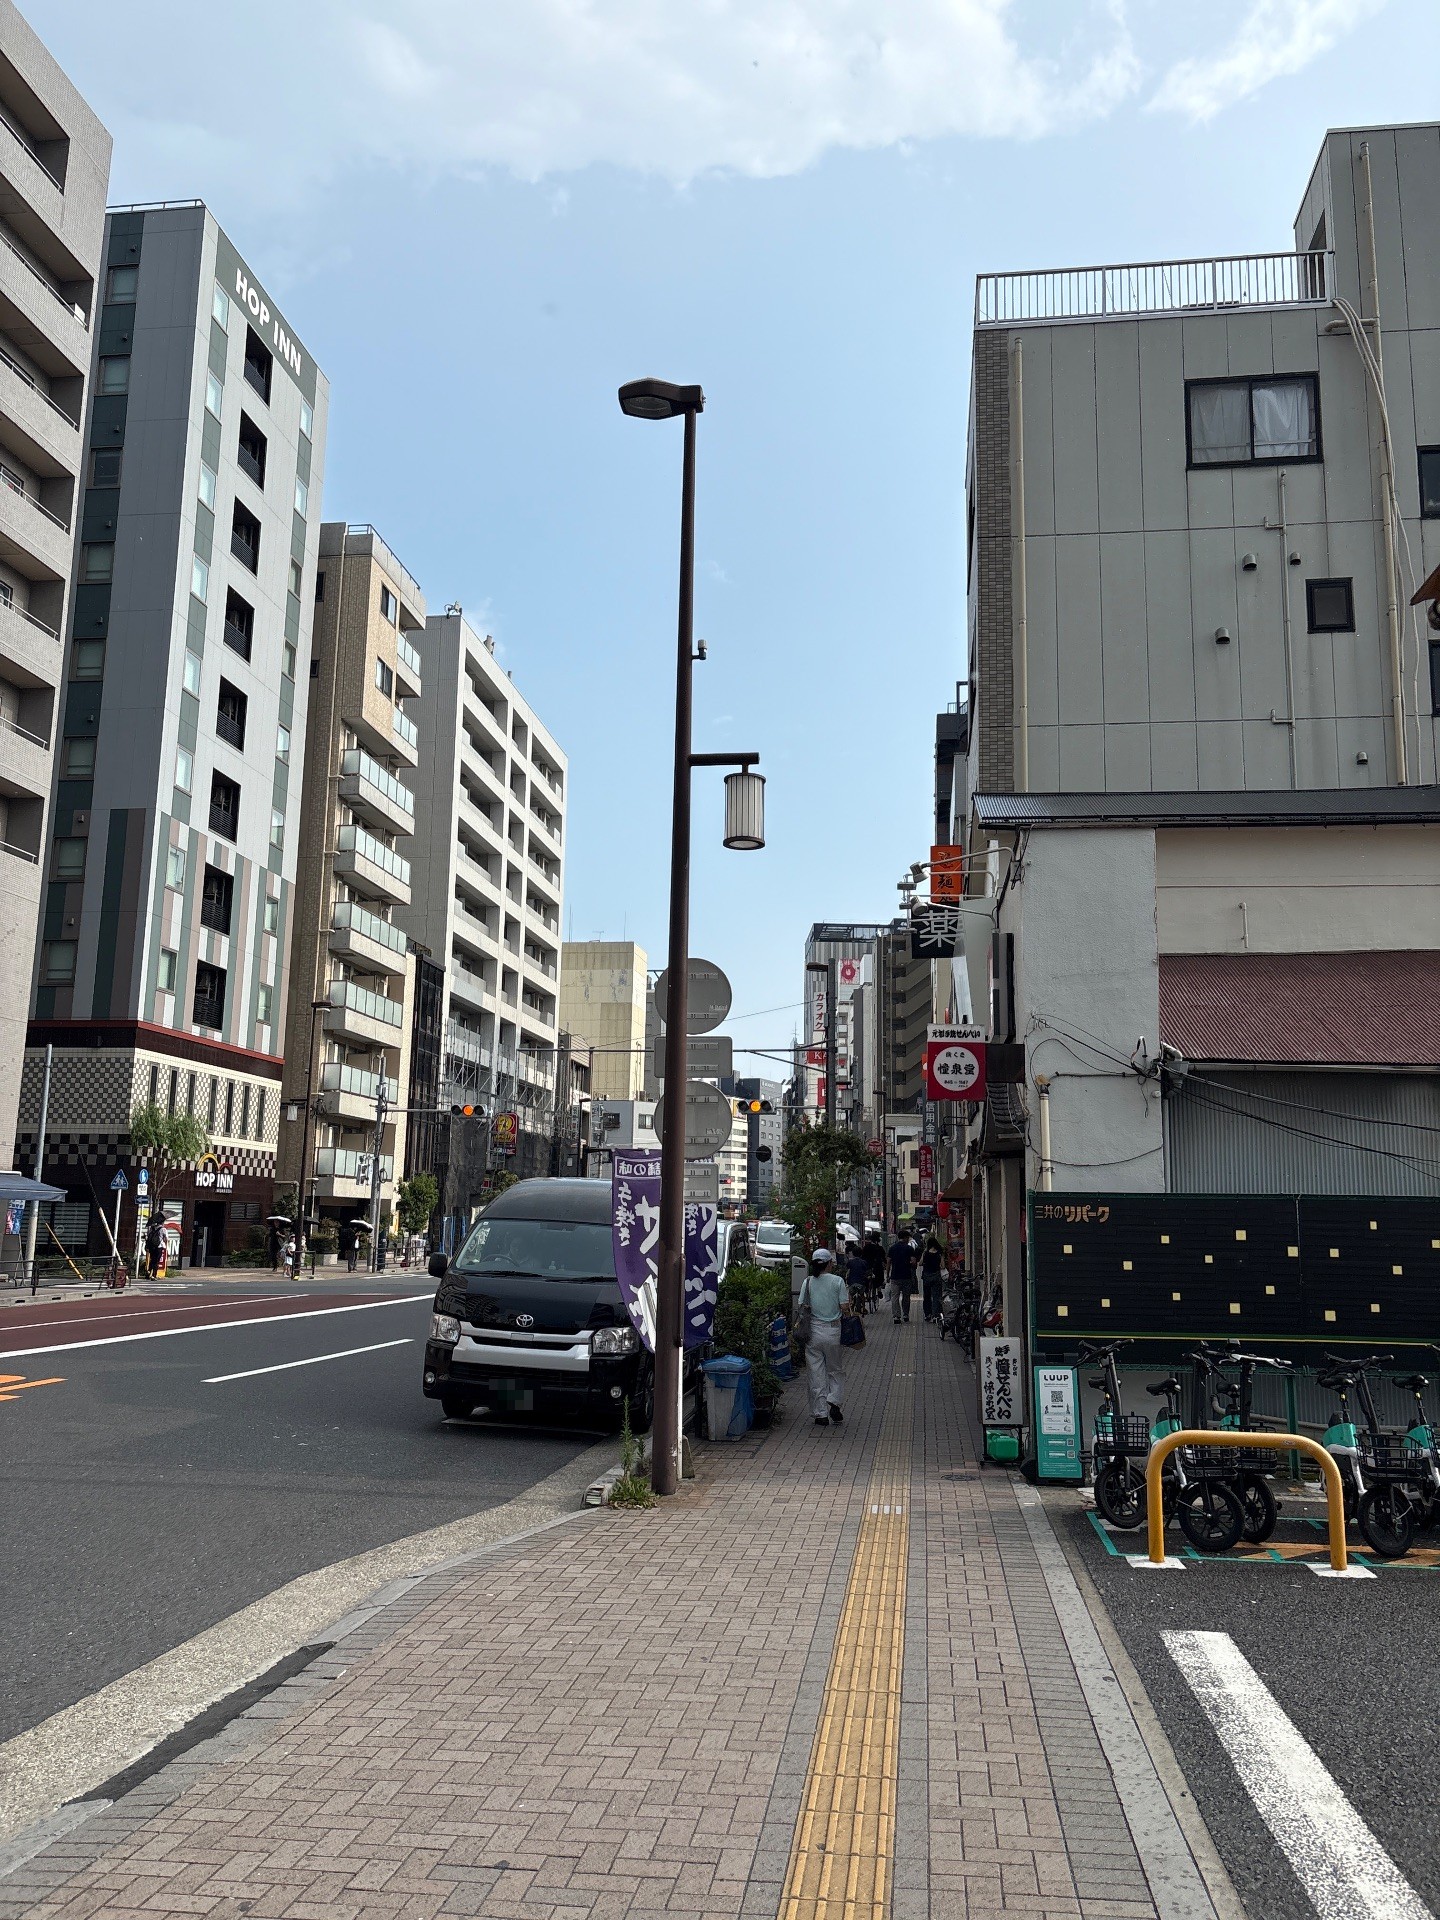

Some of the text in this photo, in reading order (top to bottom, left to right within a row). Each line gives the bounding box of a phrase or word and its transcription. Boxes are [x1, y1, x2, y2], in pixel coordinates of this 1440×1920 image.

[236, 268, 302, 377] HOP INN
[918, 910, 961, 948] 薬
[815, 992, 826, 1031] カラオケ
[925, 1101, 936, 1144] 信用金庫
[195, 1172, 234, 1189] HOP INN
[1034, 1204, 1110, 1223] 三井のリパーク
[1043, 1374, 1070, 1382] LUUP
